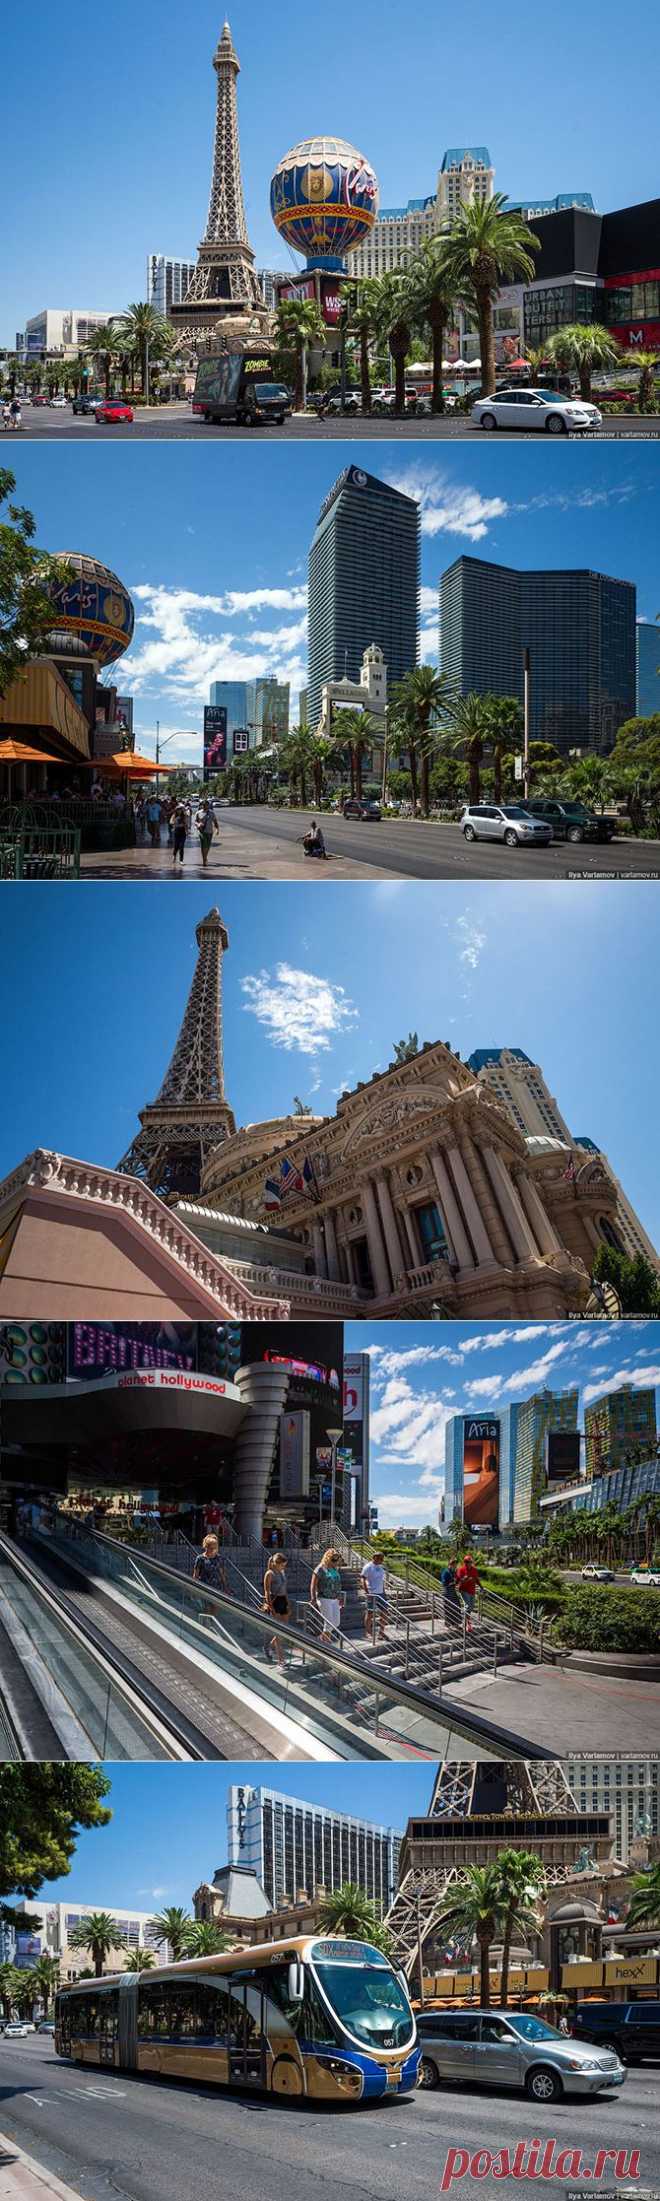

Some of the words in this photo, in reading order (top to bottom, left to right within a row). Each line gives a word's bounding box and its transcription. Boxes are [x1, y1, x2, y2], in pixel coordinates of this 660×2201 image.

[345, 159, 377, 207] Paris
[525, 287, 564, 302] URBAN
[525, 313, 552, 326] TERS
[629, 330, 643, 344] M
[244, 360, 269, 372] ZOMBIE
[48, 583, 97, 609] aris
[118, 1374, 156, 1389] planet
[160, 1373, 227, 1394] hollywood
[468, 1422, 497, 1438] Aria
